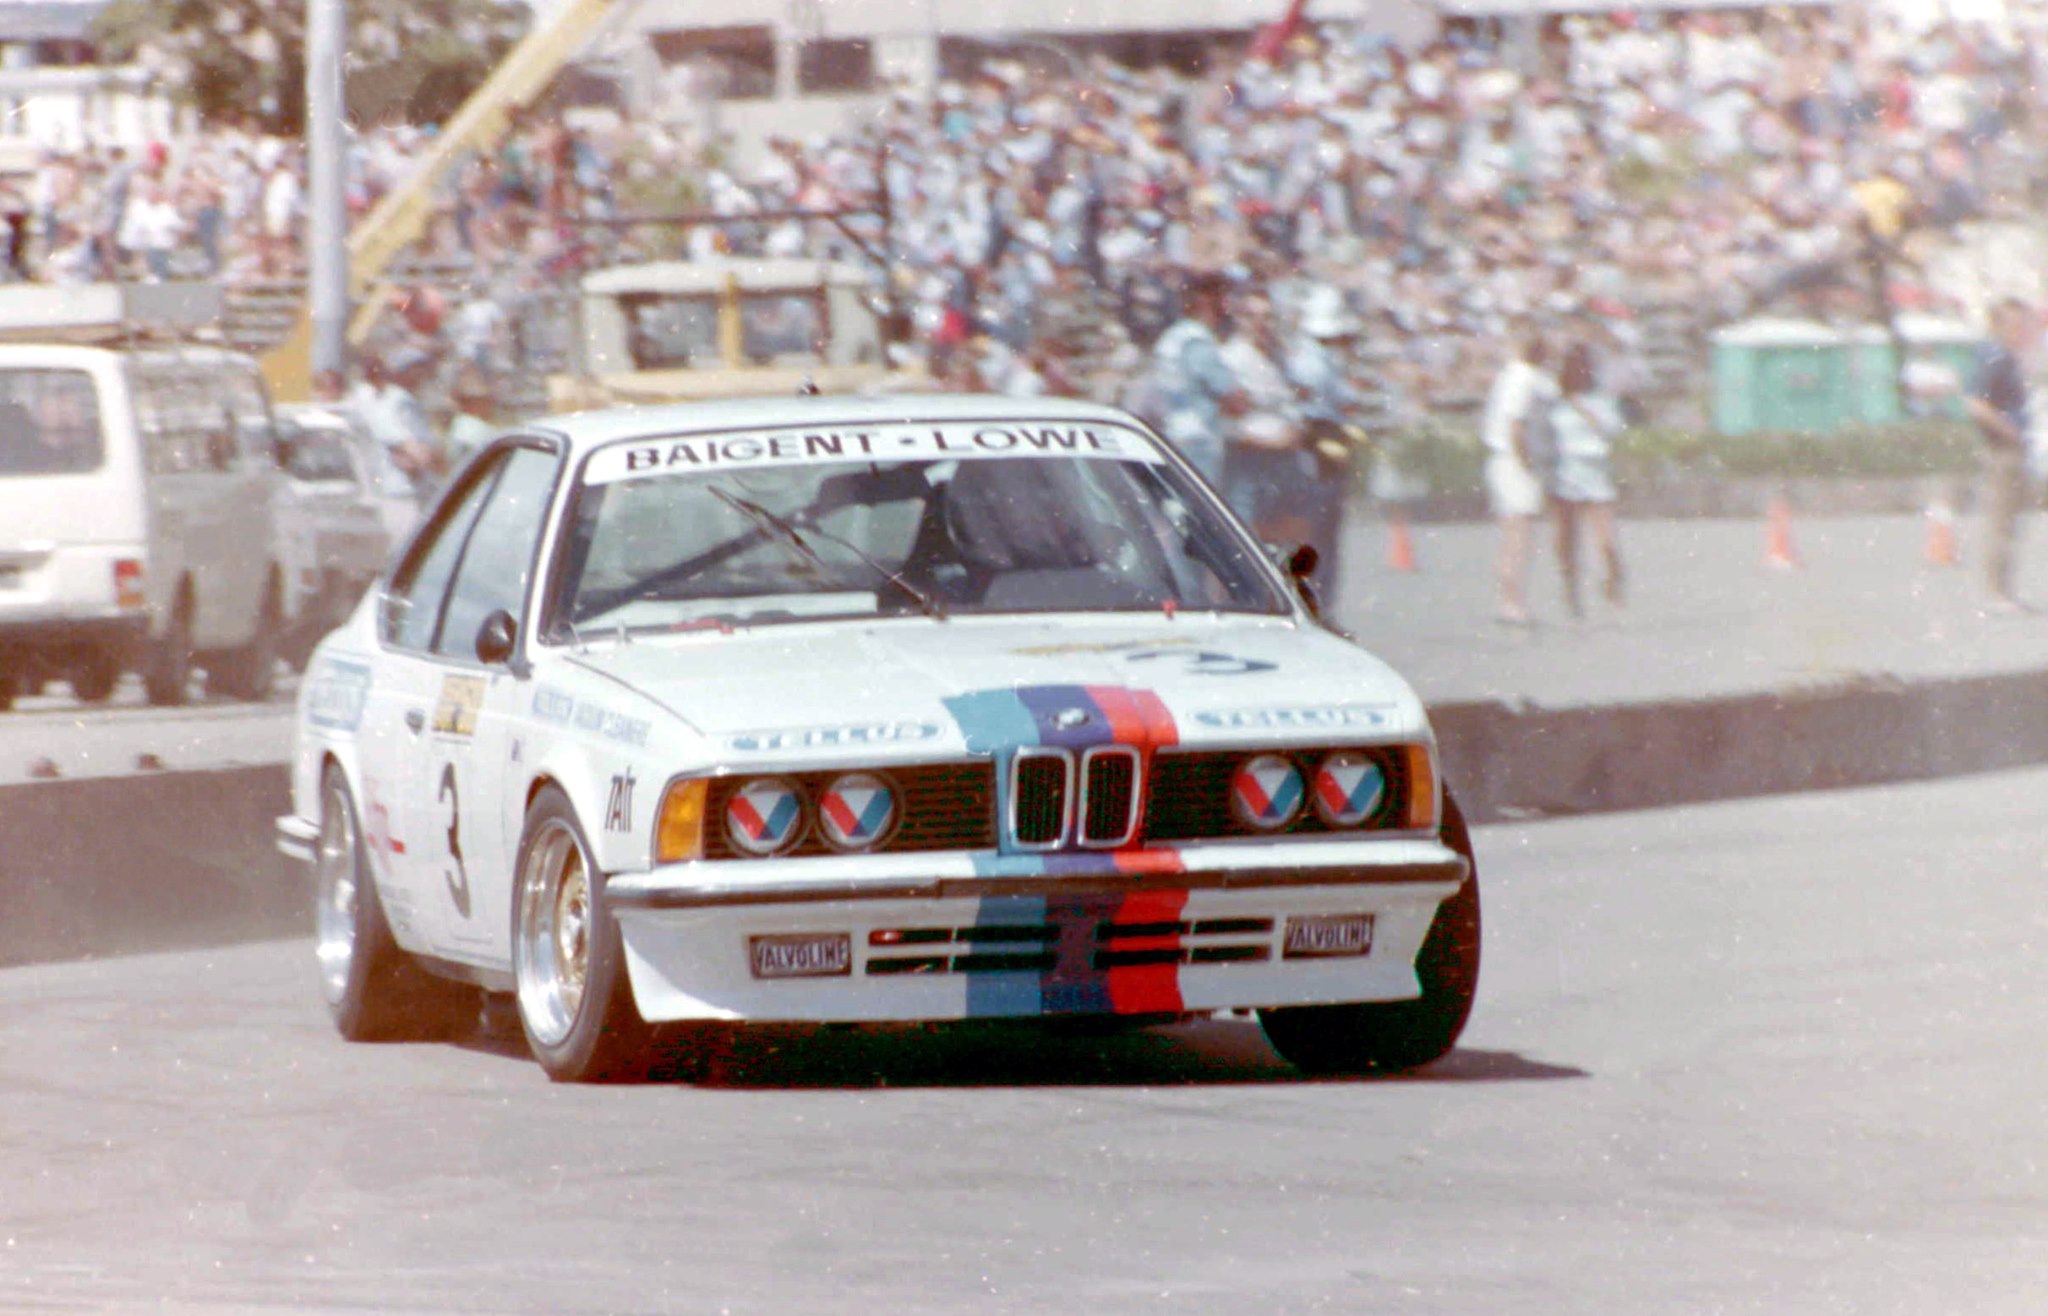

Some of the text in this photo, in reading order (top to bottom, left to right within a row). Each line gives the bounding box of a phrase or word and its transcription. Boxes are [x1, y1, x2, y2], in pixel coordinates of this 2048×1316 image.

[626, 427, 1122, 471] BAIGENT LOWE
[438, 762, 472, 919] 3
[1287, 920, 1371, 949] VALVOLINE
[755, 938, 848, 971] VALVOLINE
